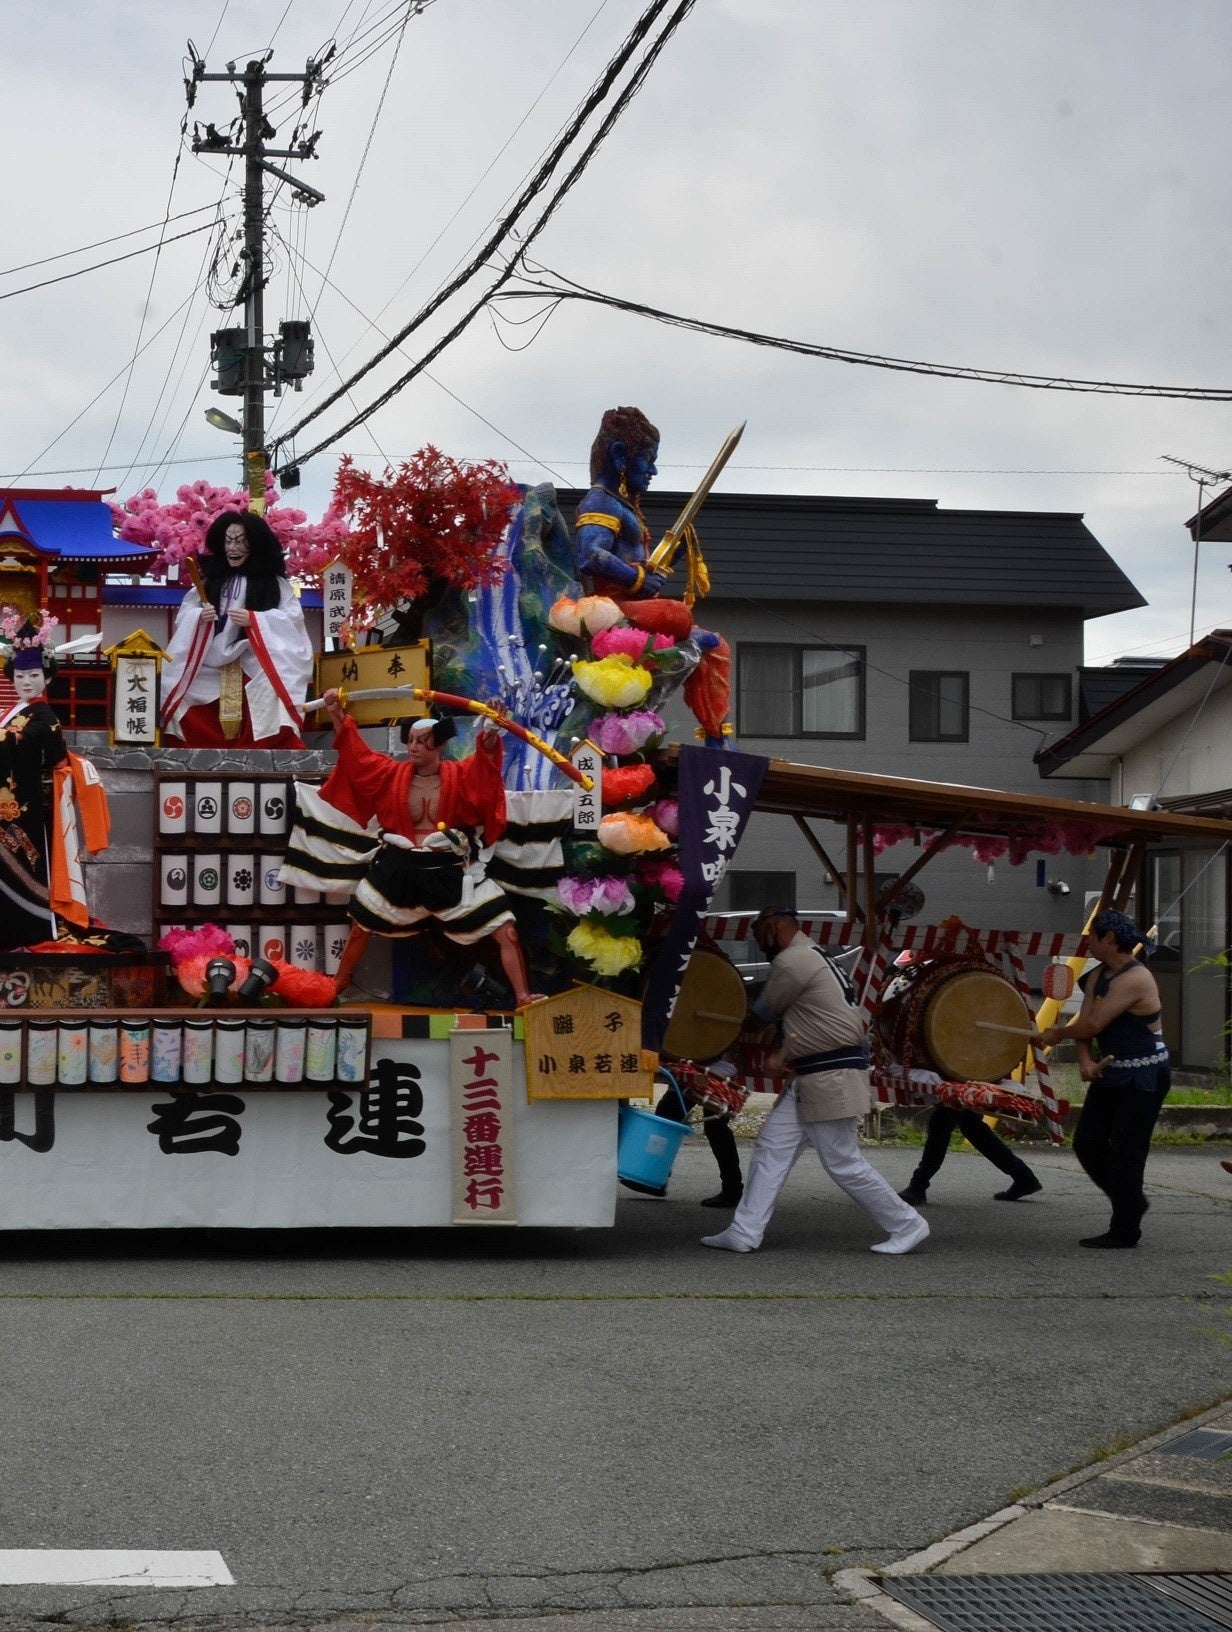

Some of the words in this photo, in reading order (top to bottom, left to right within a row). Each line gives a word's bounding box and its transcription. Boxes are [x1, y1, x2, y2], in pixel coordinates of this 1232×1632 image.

[125, 674, 149, 735] 大福帳
[577, 756, 595, 824] 成五郎
[538, 1052, 639, 1075] 小泉若連
[461, 1045, 504, 1210] 十三番運行
